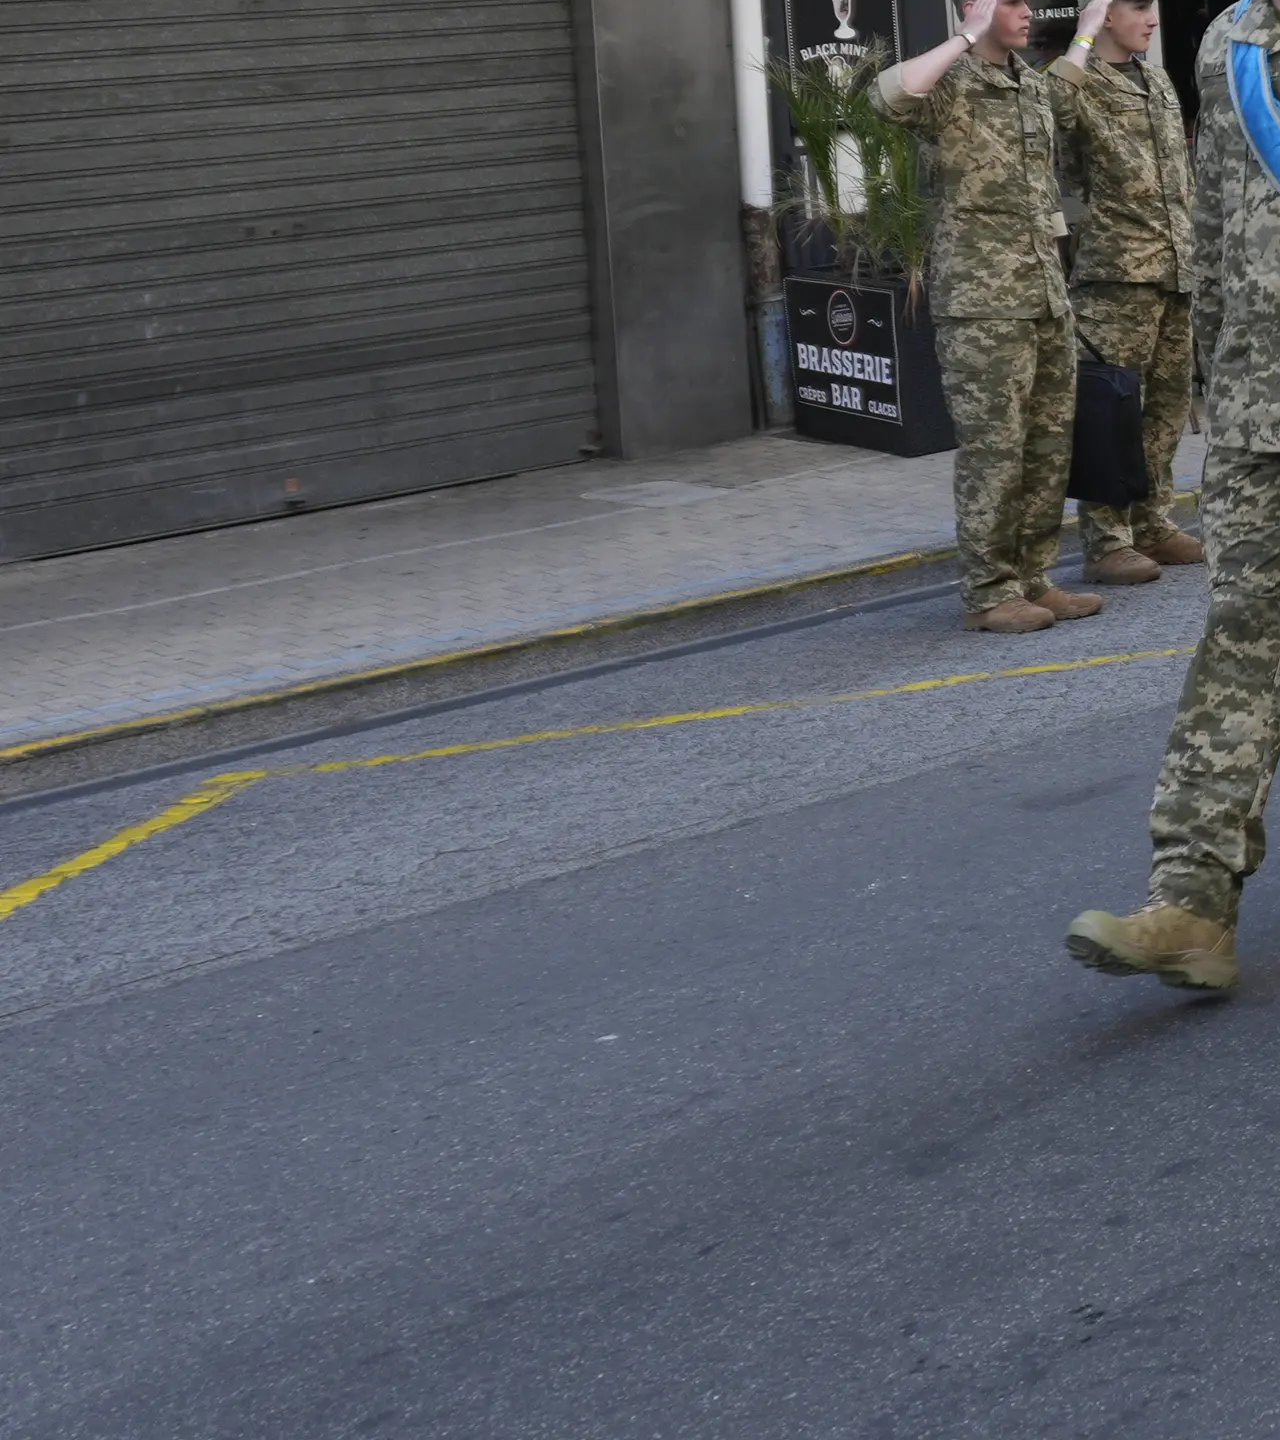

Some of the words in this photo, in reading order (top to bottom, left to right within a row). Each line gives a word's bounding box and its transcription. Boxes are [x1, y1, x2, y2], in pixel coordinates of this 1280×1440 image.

[800, 43, 838, 61] BLACK
[839, 43, 868, 59] MINT
[797, 343, 893, 385] BRASSERIE
[799, 386, 827, 404] CRÊPES
[830, 383, 862, 410] BAR
[868, 400, 897, 418] GLACES
